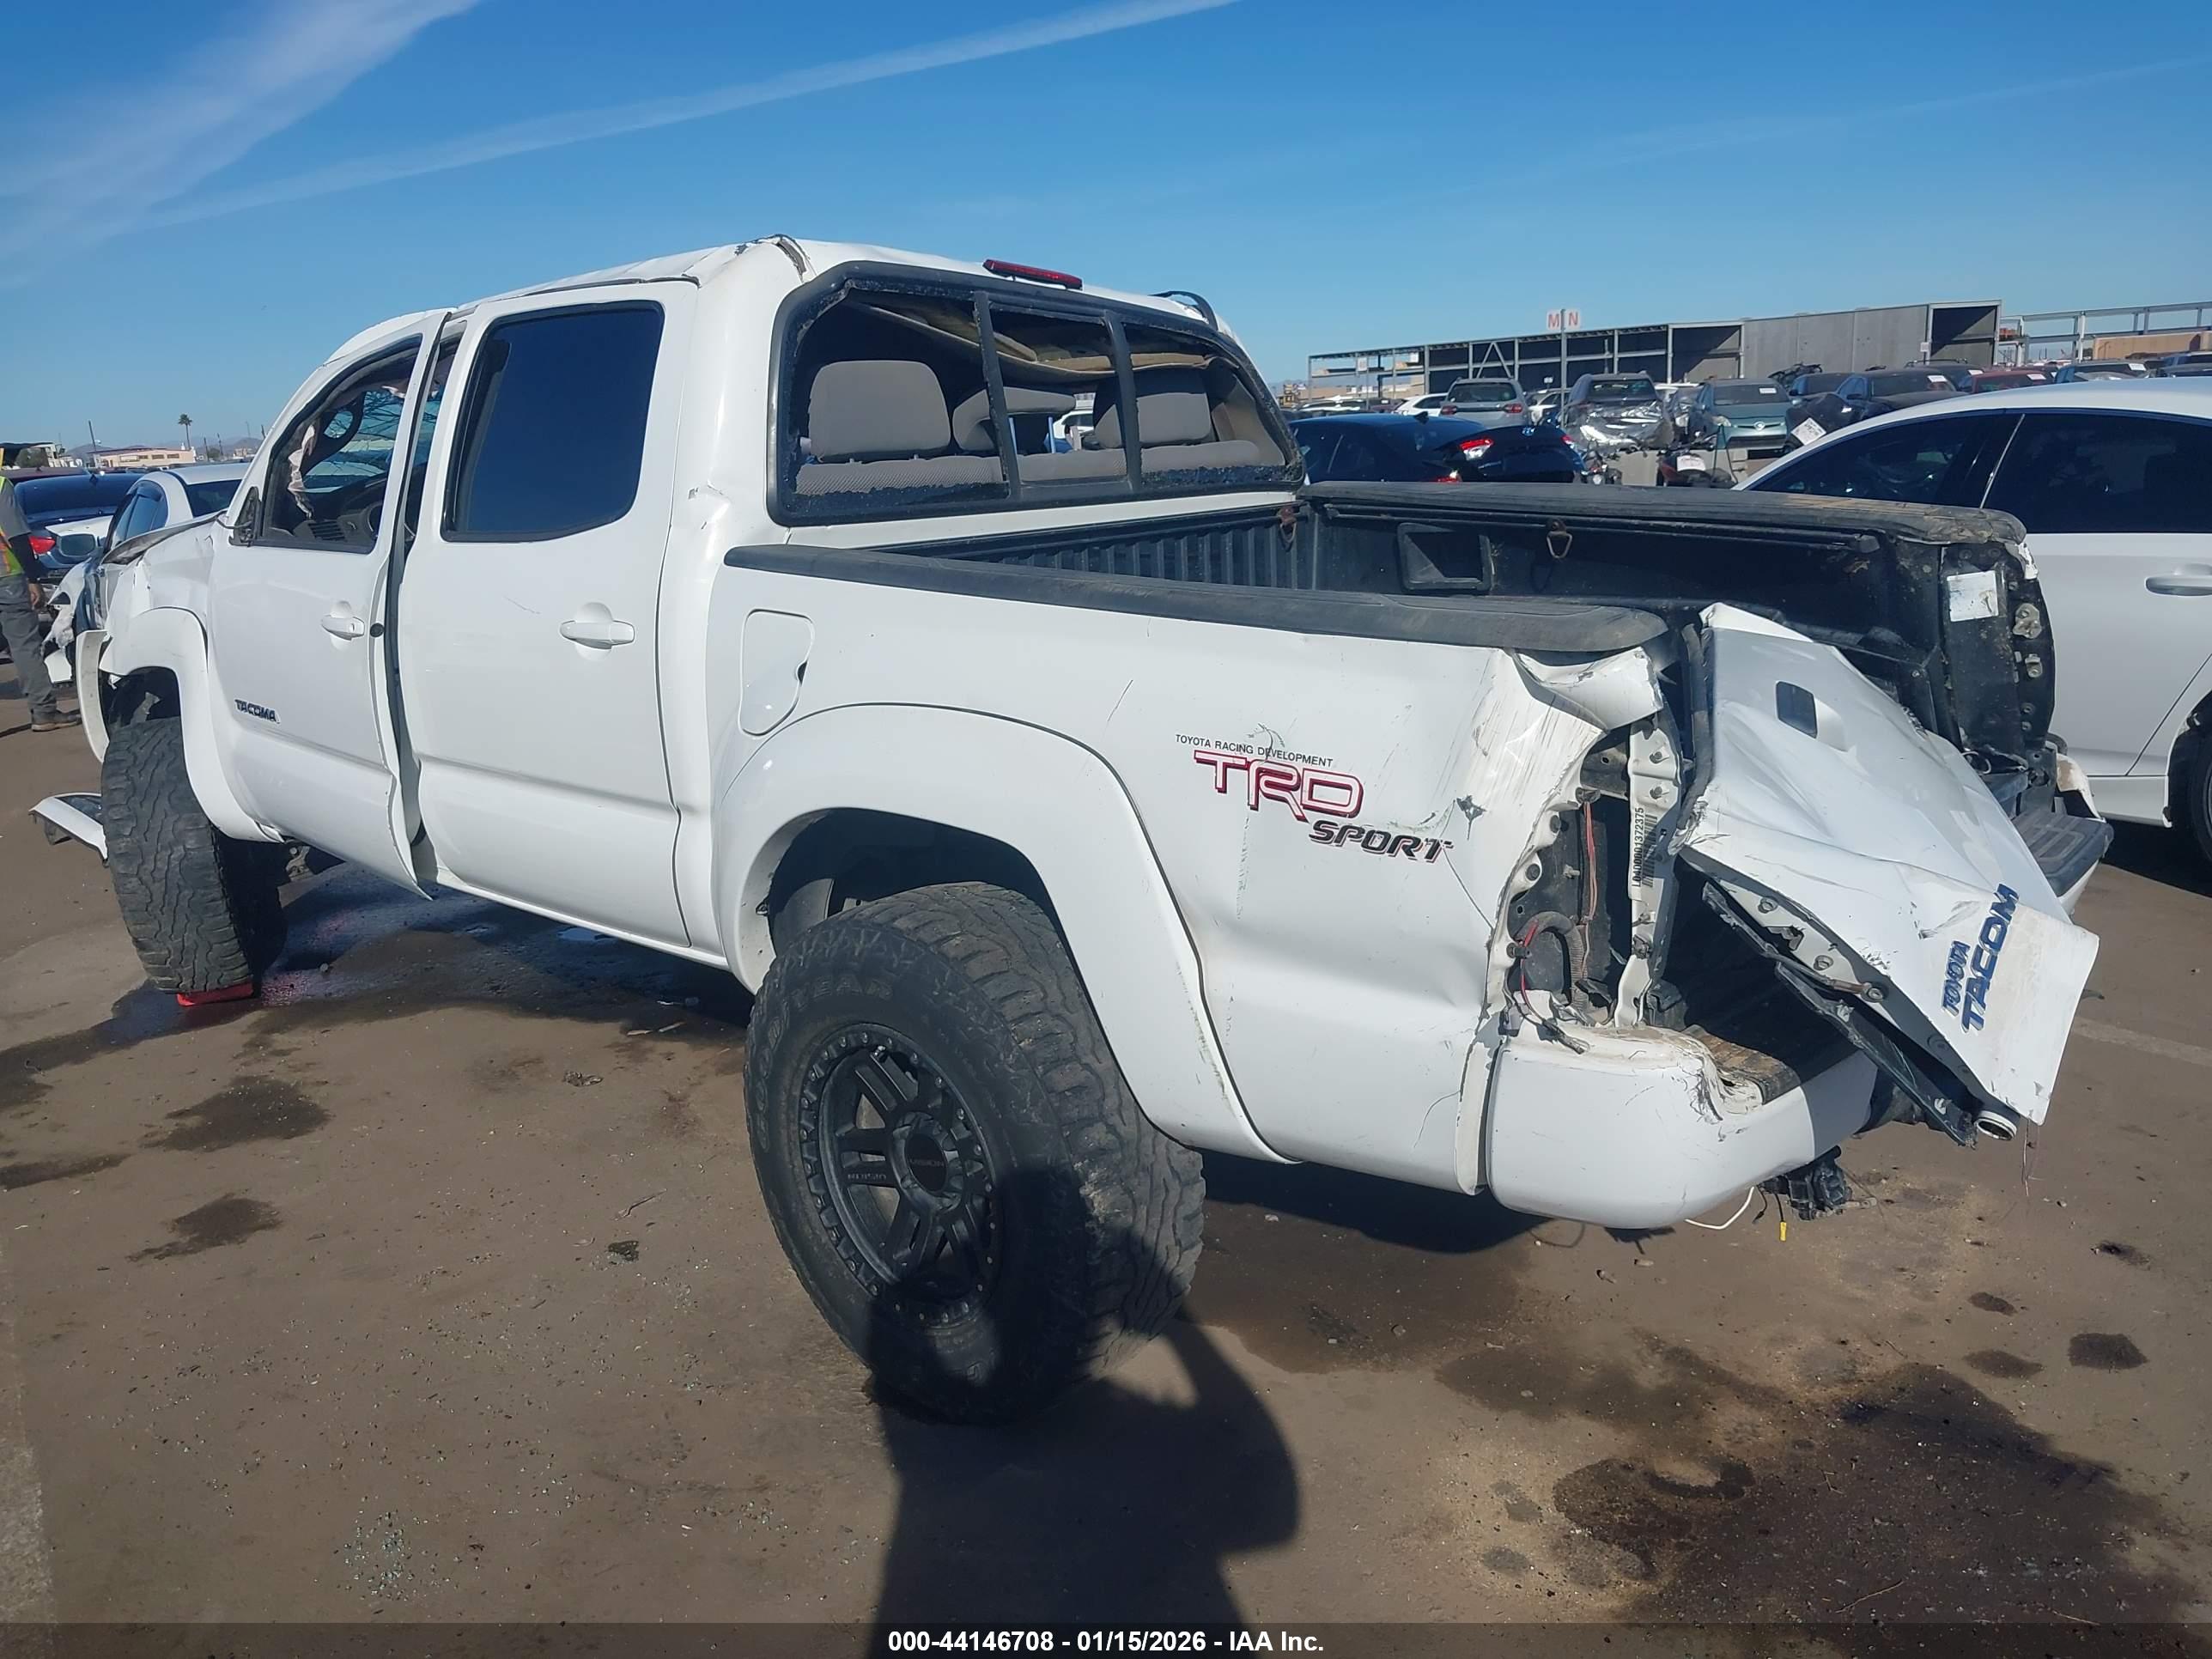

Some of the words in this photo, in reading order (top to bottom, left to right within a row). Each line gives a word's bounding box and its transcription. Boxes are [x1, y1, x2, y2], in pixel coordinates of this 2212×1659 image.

[1547, 313, 1559, 328] M
[1568, 312, 1578, 326] N
[234, 699, 279, 723] TACOMA
[1175, 733, 1212, 749] TOYOTA
[1214, 740, 1254, 755] RACING
[1257, 746, 1334, 769] DEVELOPMENT
[1194, 750, 1364, 823] TRD
[1308, 819, 1454, 864] SPORT
[1942, 940, 1972, 1018] TOYOTA
